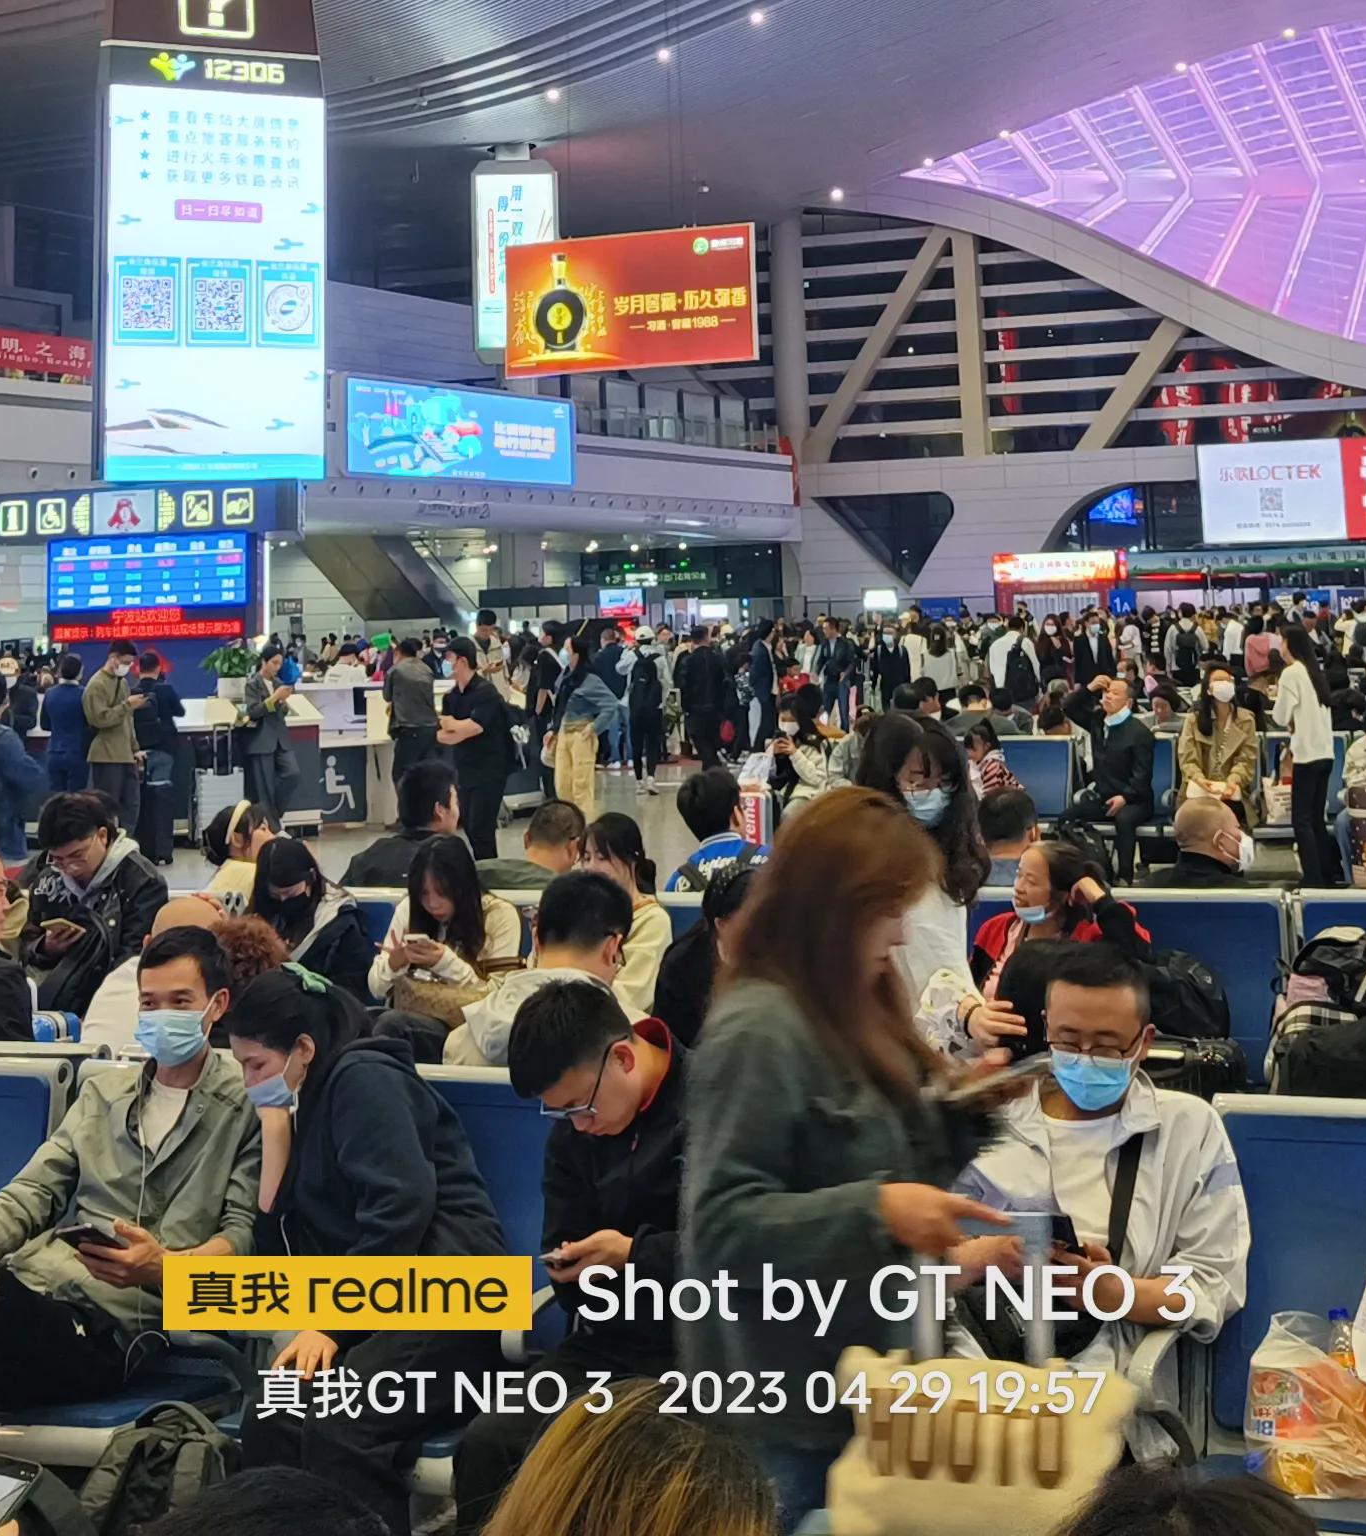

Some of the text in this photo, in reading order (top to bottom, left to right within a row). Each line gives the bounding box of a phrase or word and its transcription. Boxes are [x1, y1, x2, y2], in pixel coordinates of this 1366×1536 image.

[204, 58, 285, 84] 12306
[510, 184, 524, 244] 用一双
[1113, 596, 1132, 614] 1A
